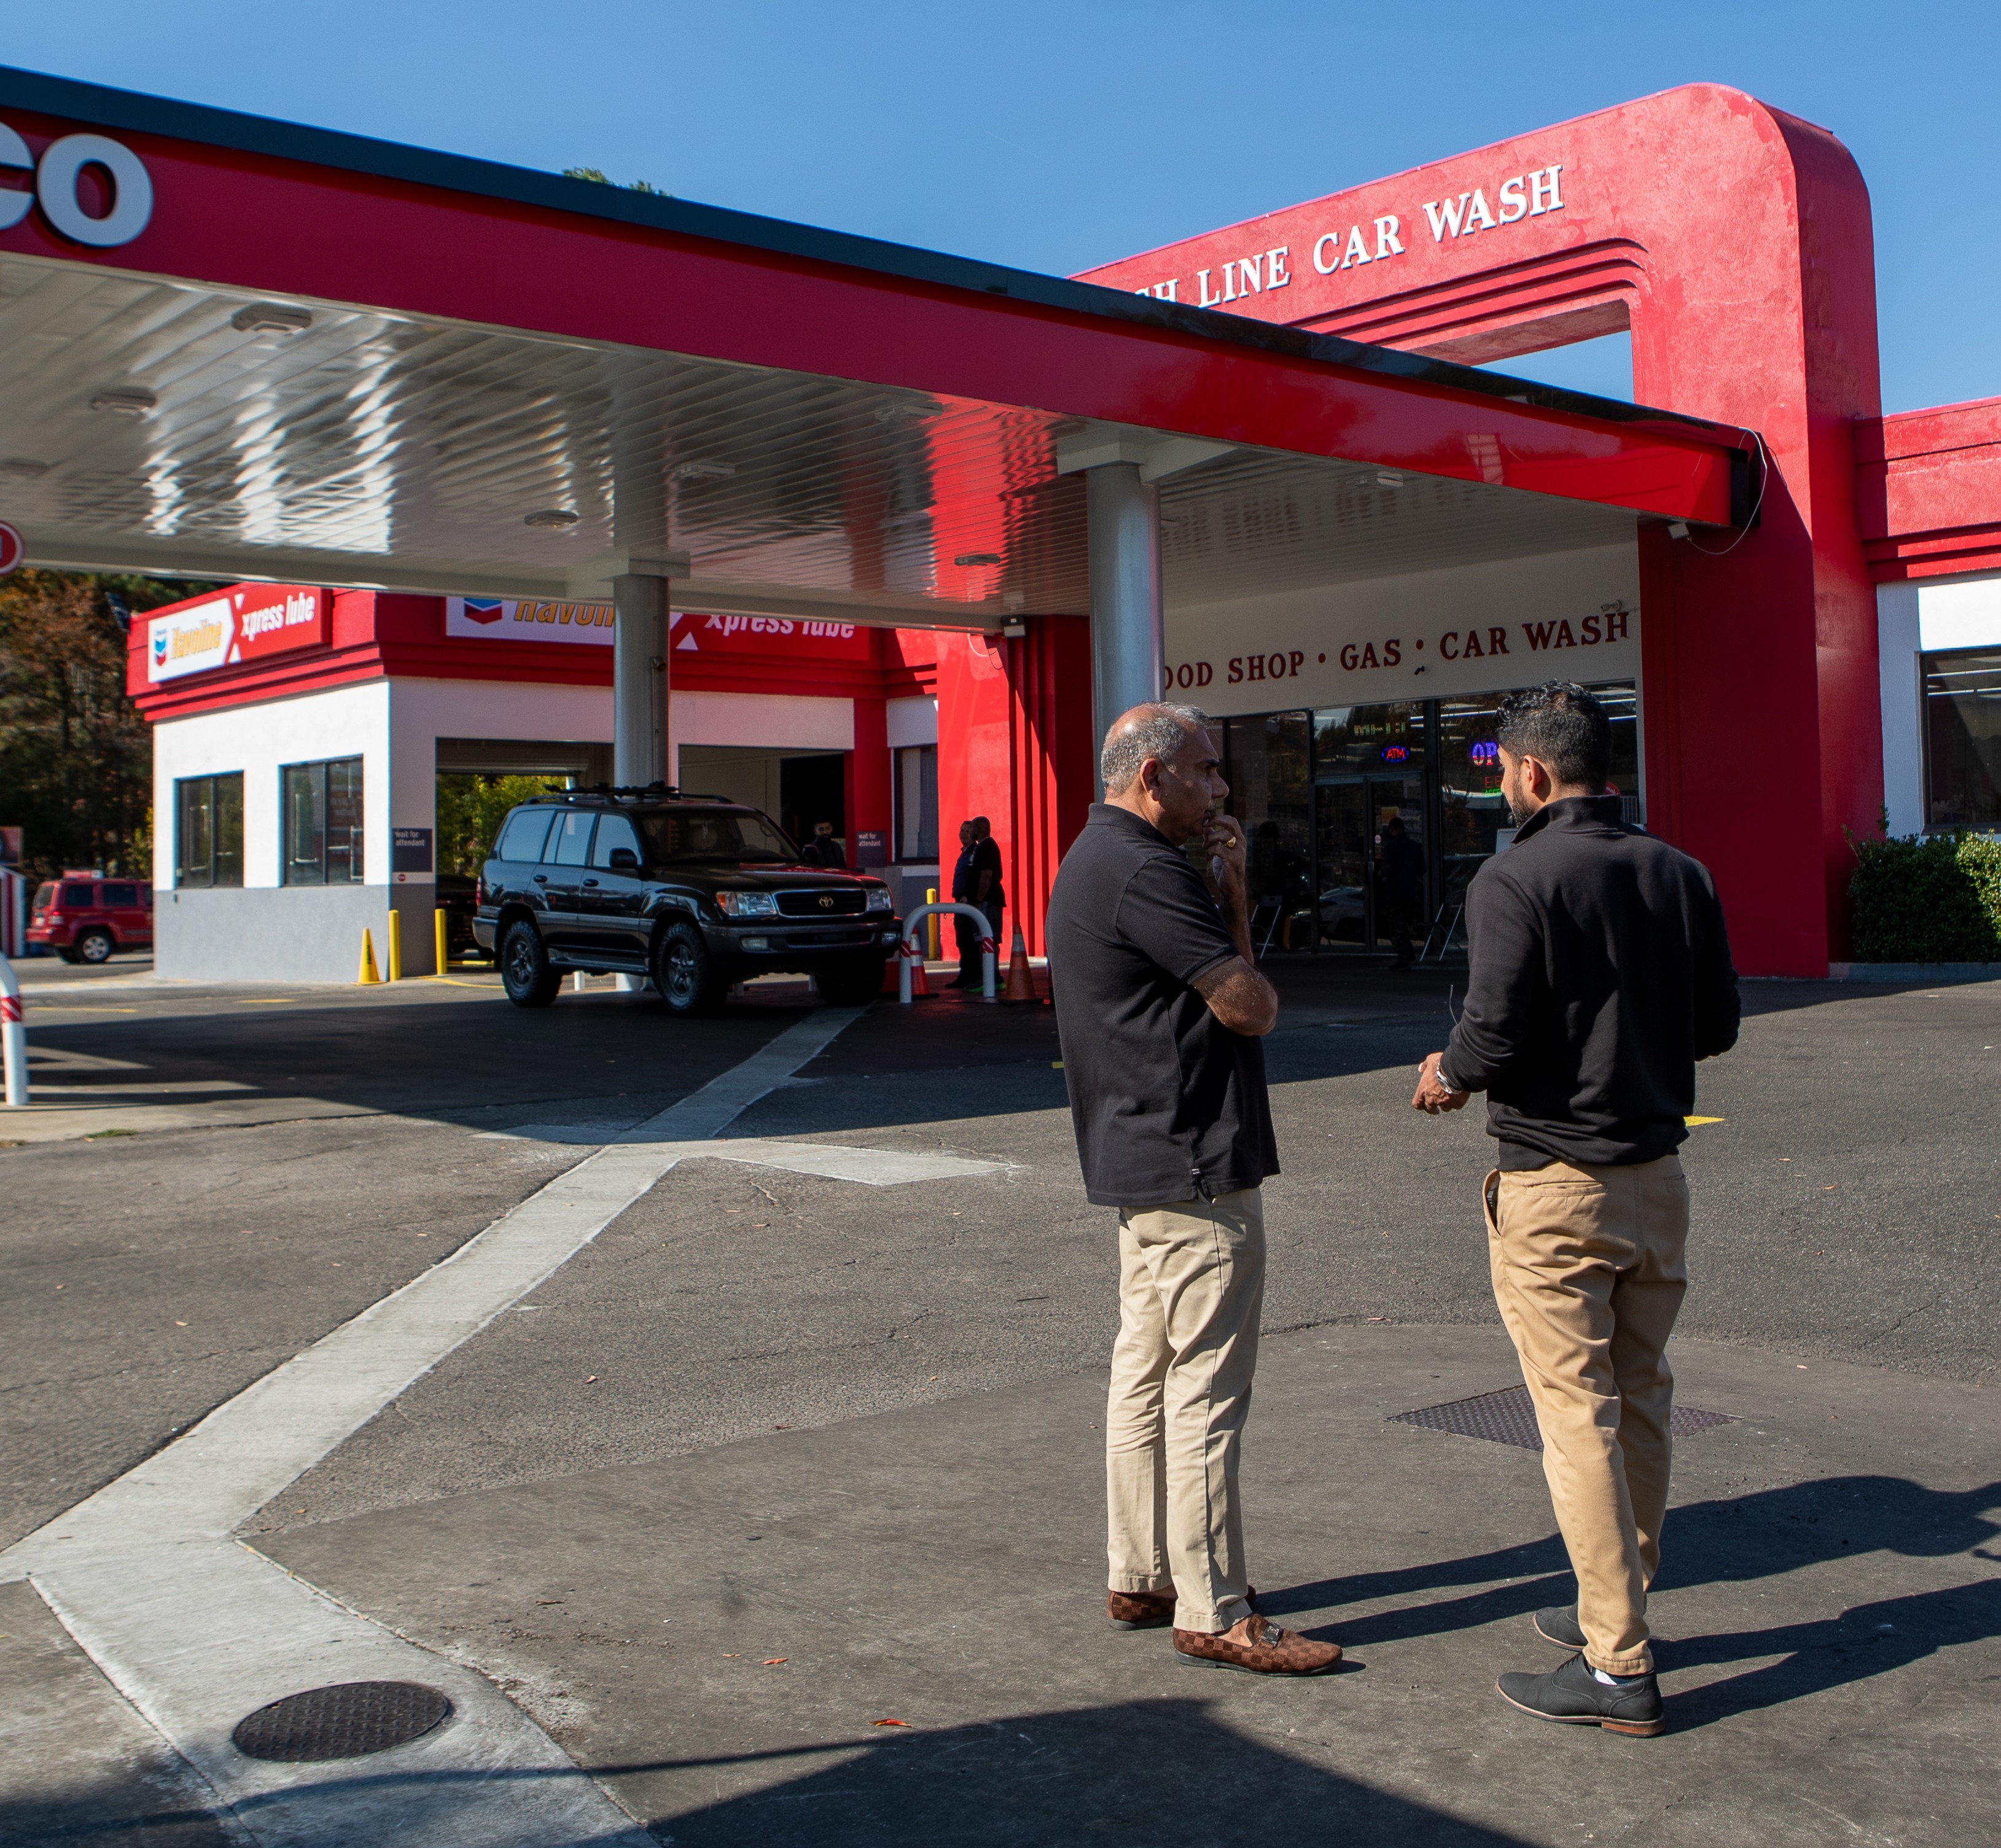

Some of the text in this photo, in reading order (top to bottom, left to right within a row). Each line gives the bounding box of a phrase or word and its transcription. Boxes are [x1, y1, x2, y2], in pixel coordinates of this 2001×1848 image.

[1197, 246, 1291, 308] LINE
[1313, 214, 1405, 275] CAR
[1422, 164, 1564, 243] WASH
[285, 591, 316, 625] lube
[1228, 651, 1305, 684] SHOP
[1340, 639, 1401, 671] GAS
[1440, 626, 1510, 660] CAR
[1521, 612, 1629, 651] WASH
[1386, 747, 1405, 760] ATM
